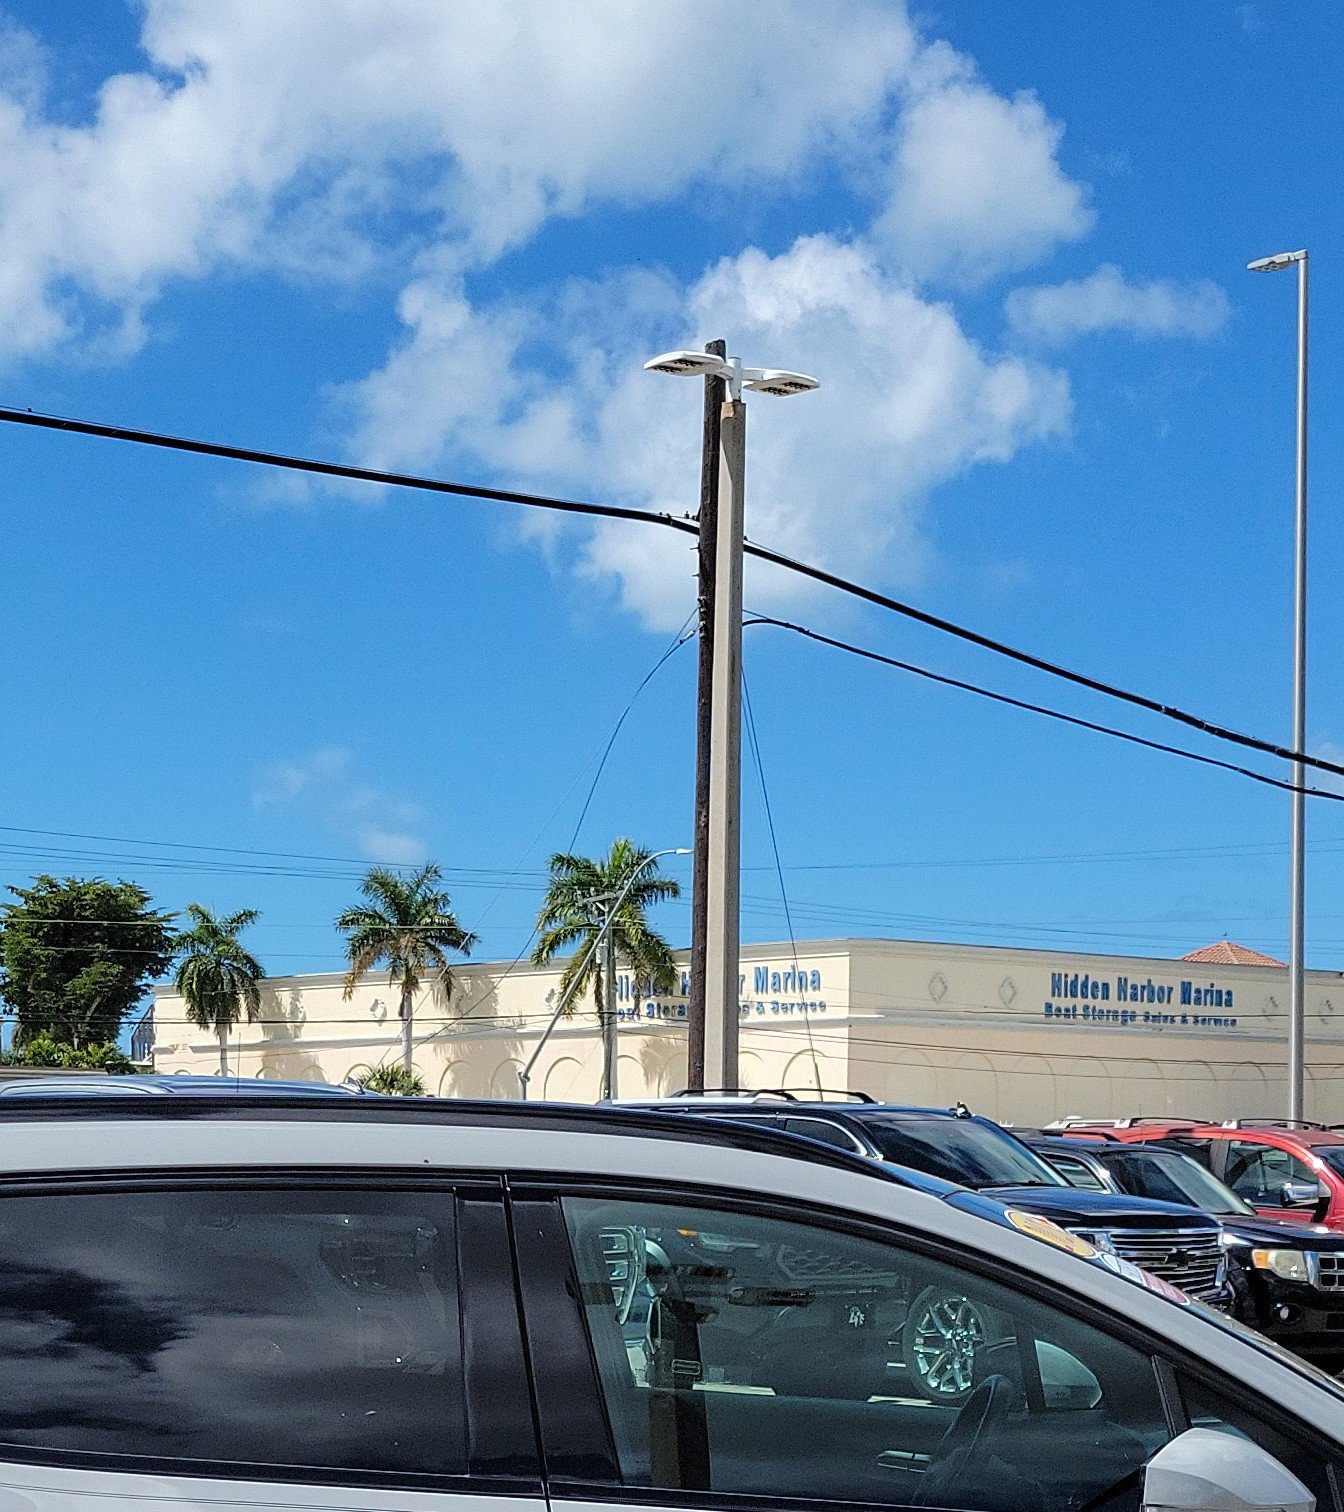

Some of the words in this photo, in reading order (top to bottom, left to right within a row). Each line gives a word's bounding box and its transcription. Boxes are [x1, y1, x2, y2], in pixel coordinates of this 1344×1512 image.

[754, 964, 821, 995] Marina
[1051, 972, 1110, 1000] Hidden
[1117, 977, 1174, 1004] Harbor
[1180, 981, 1233, 1008] Marina
[1044, 1002, 1077, 1019] Boat
[1082, 1004, 1137, 1026] Storage
